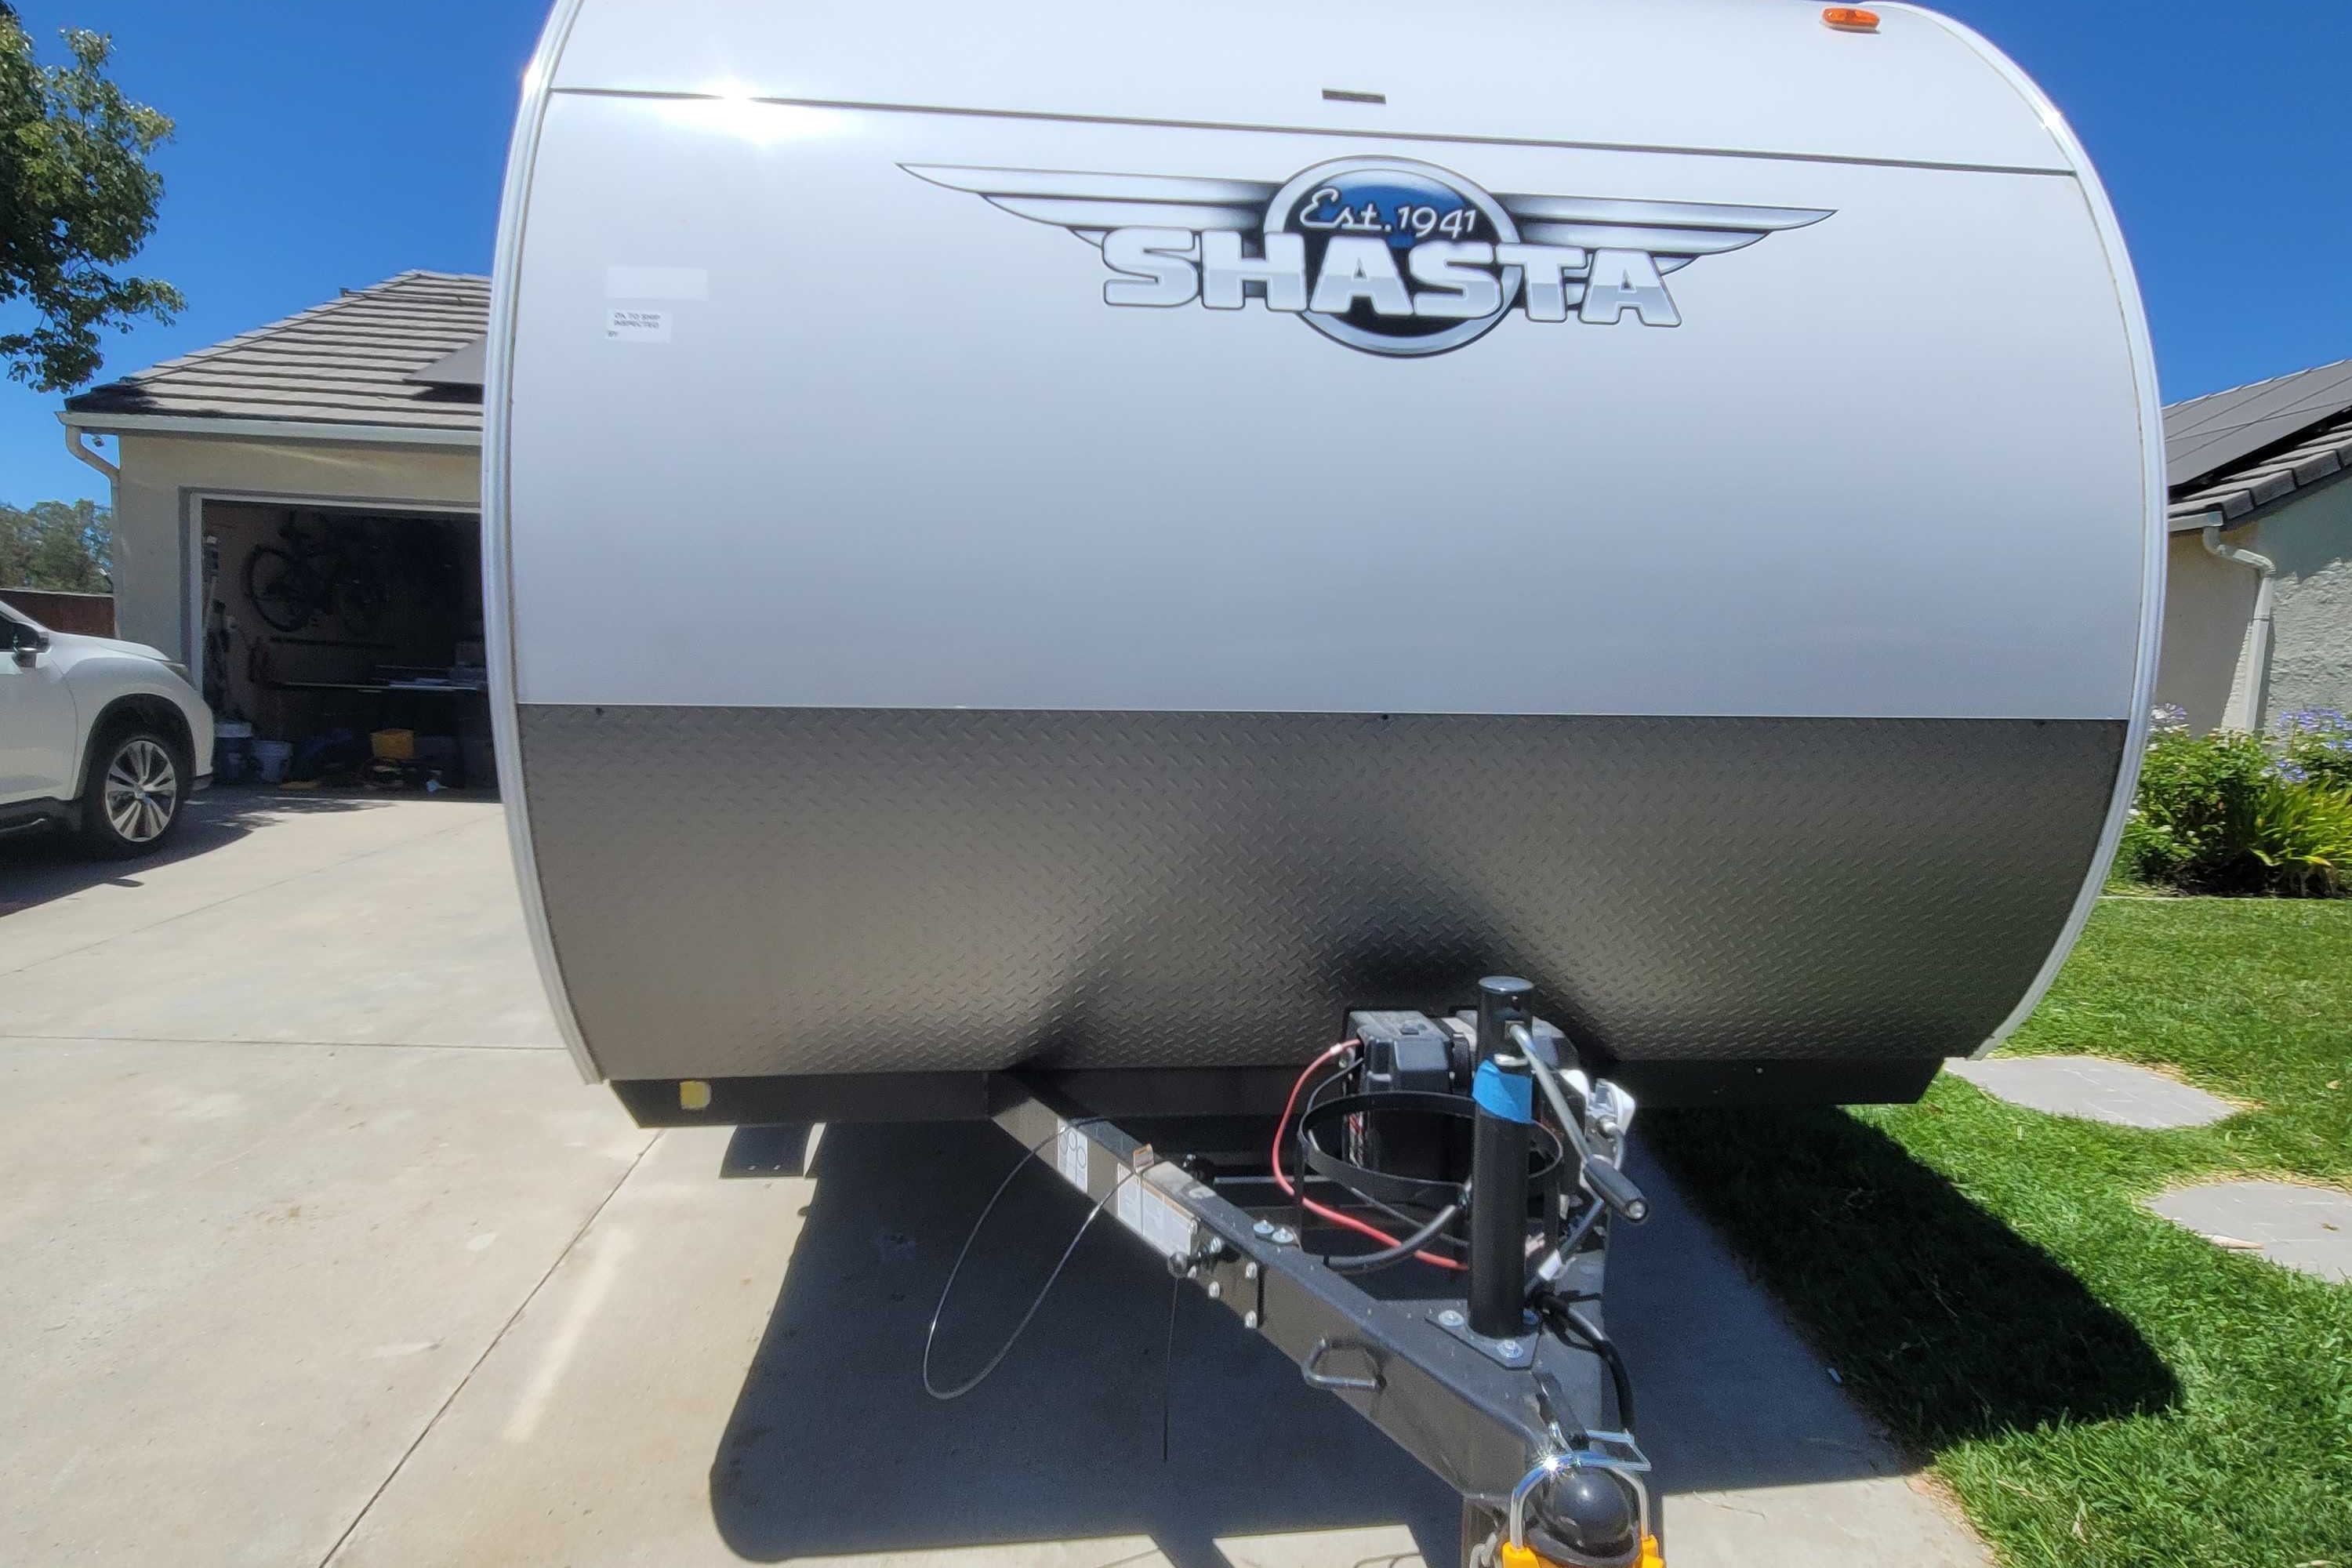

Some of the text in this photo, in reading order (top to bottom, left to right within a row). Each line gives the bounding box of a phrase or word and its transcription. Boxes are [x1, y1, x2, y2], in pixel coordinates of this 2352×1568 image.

[1300, 188, 1476, 239] Est. 1941
[1102, 225, 1682, 328] SHASTA
